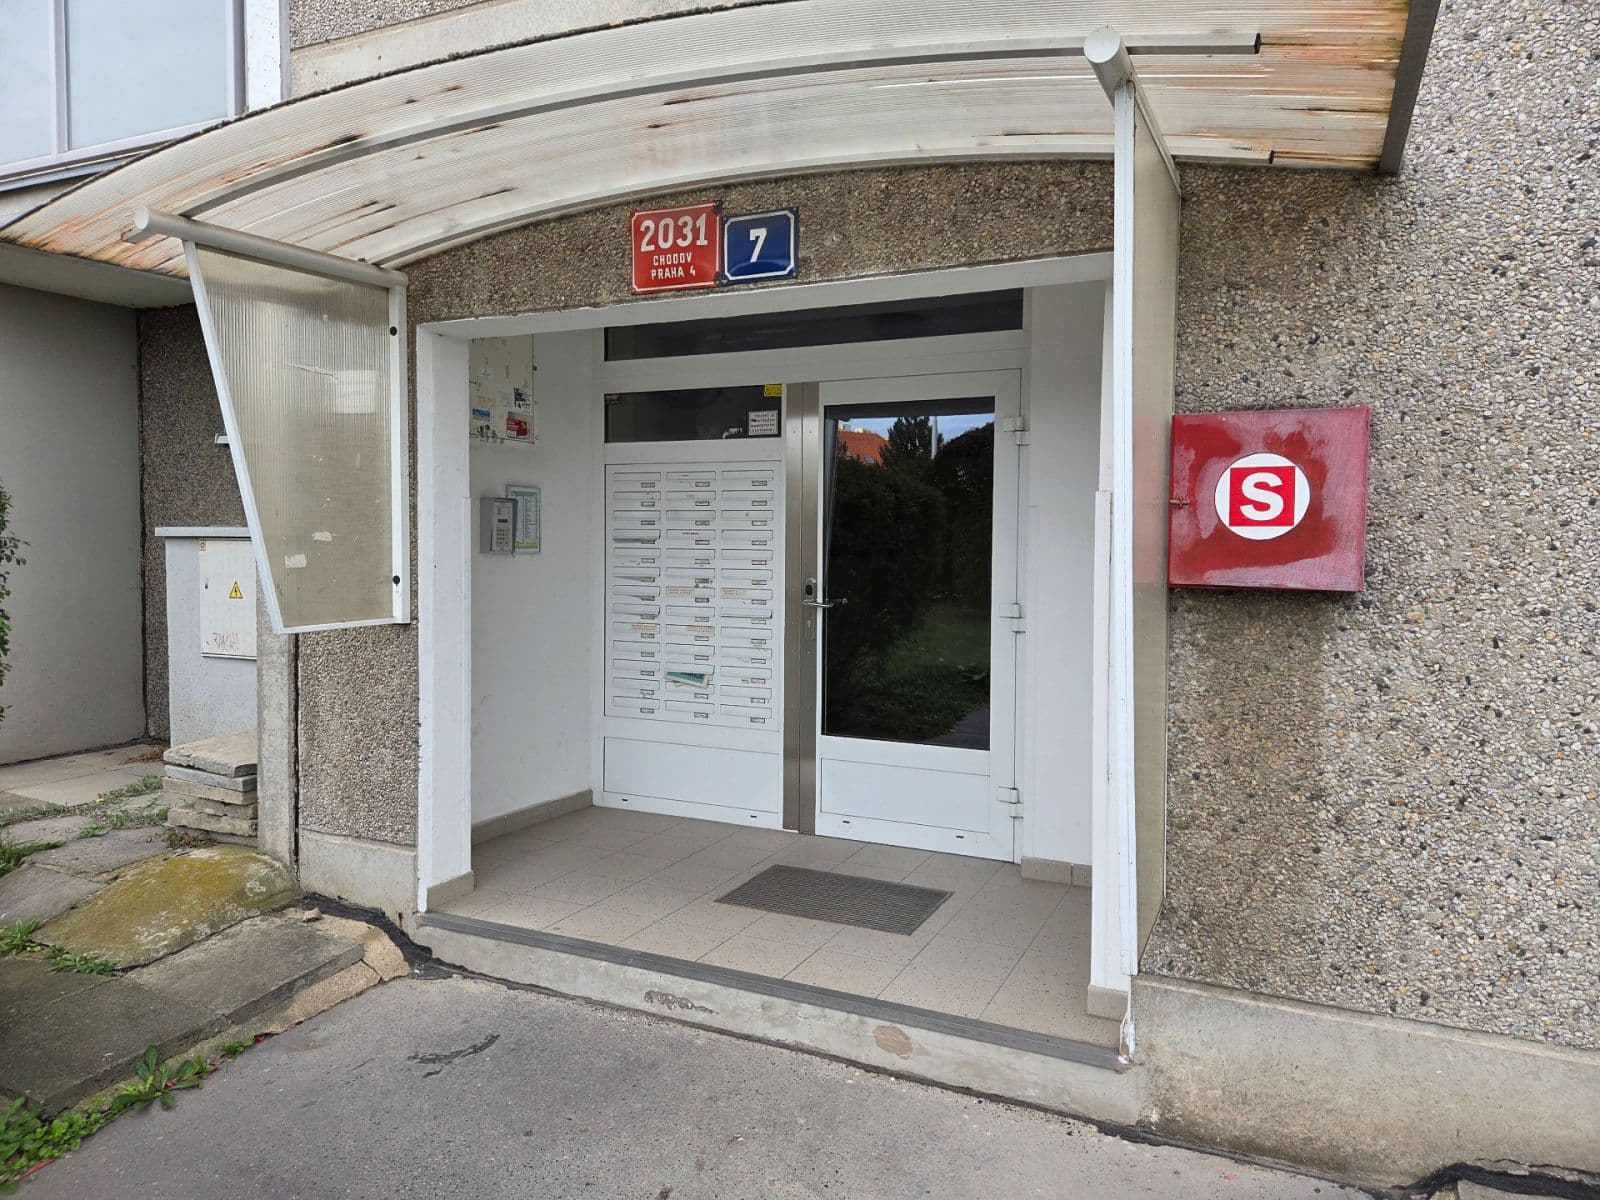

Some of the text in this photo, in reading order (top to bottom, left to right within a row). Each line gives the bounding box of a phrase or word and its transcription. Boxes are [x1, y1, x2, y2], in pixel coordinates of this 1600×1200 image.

[639, 212, 709, 253] 2031
[749, 227, 768, 263] 7
[651, 265, 696, 280] PRAHA 4
[653, 251, 693, 266] CHODOV
[1239, 472, 1284, 521] S
